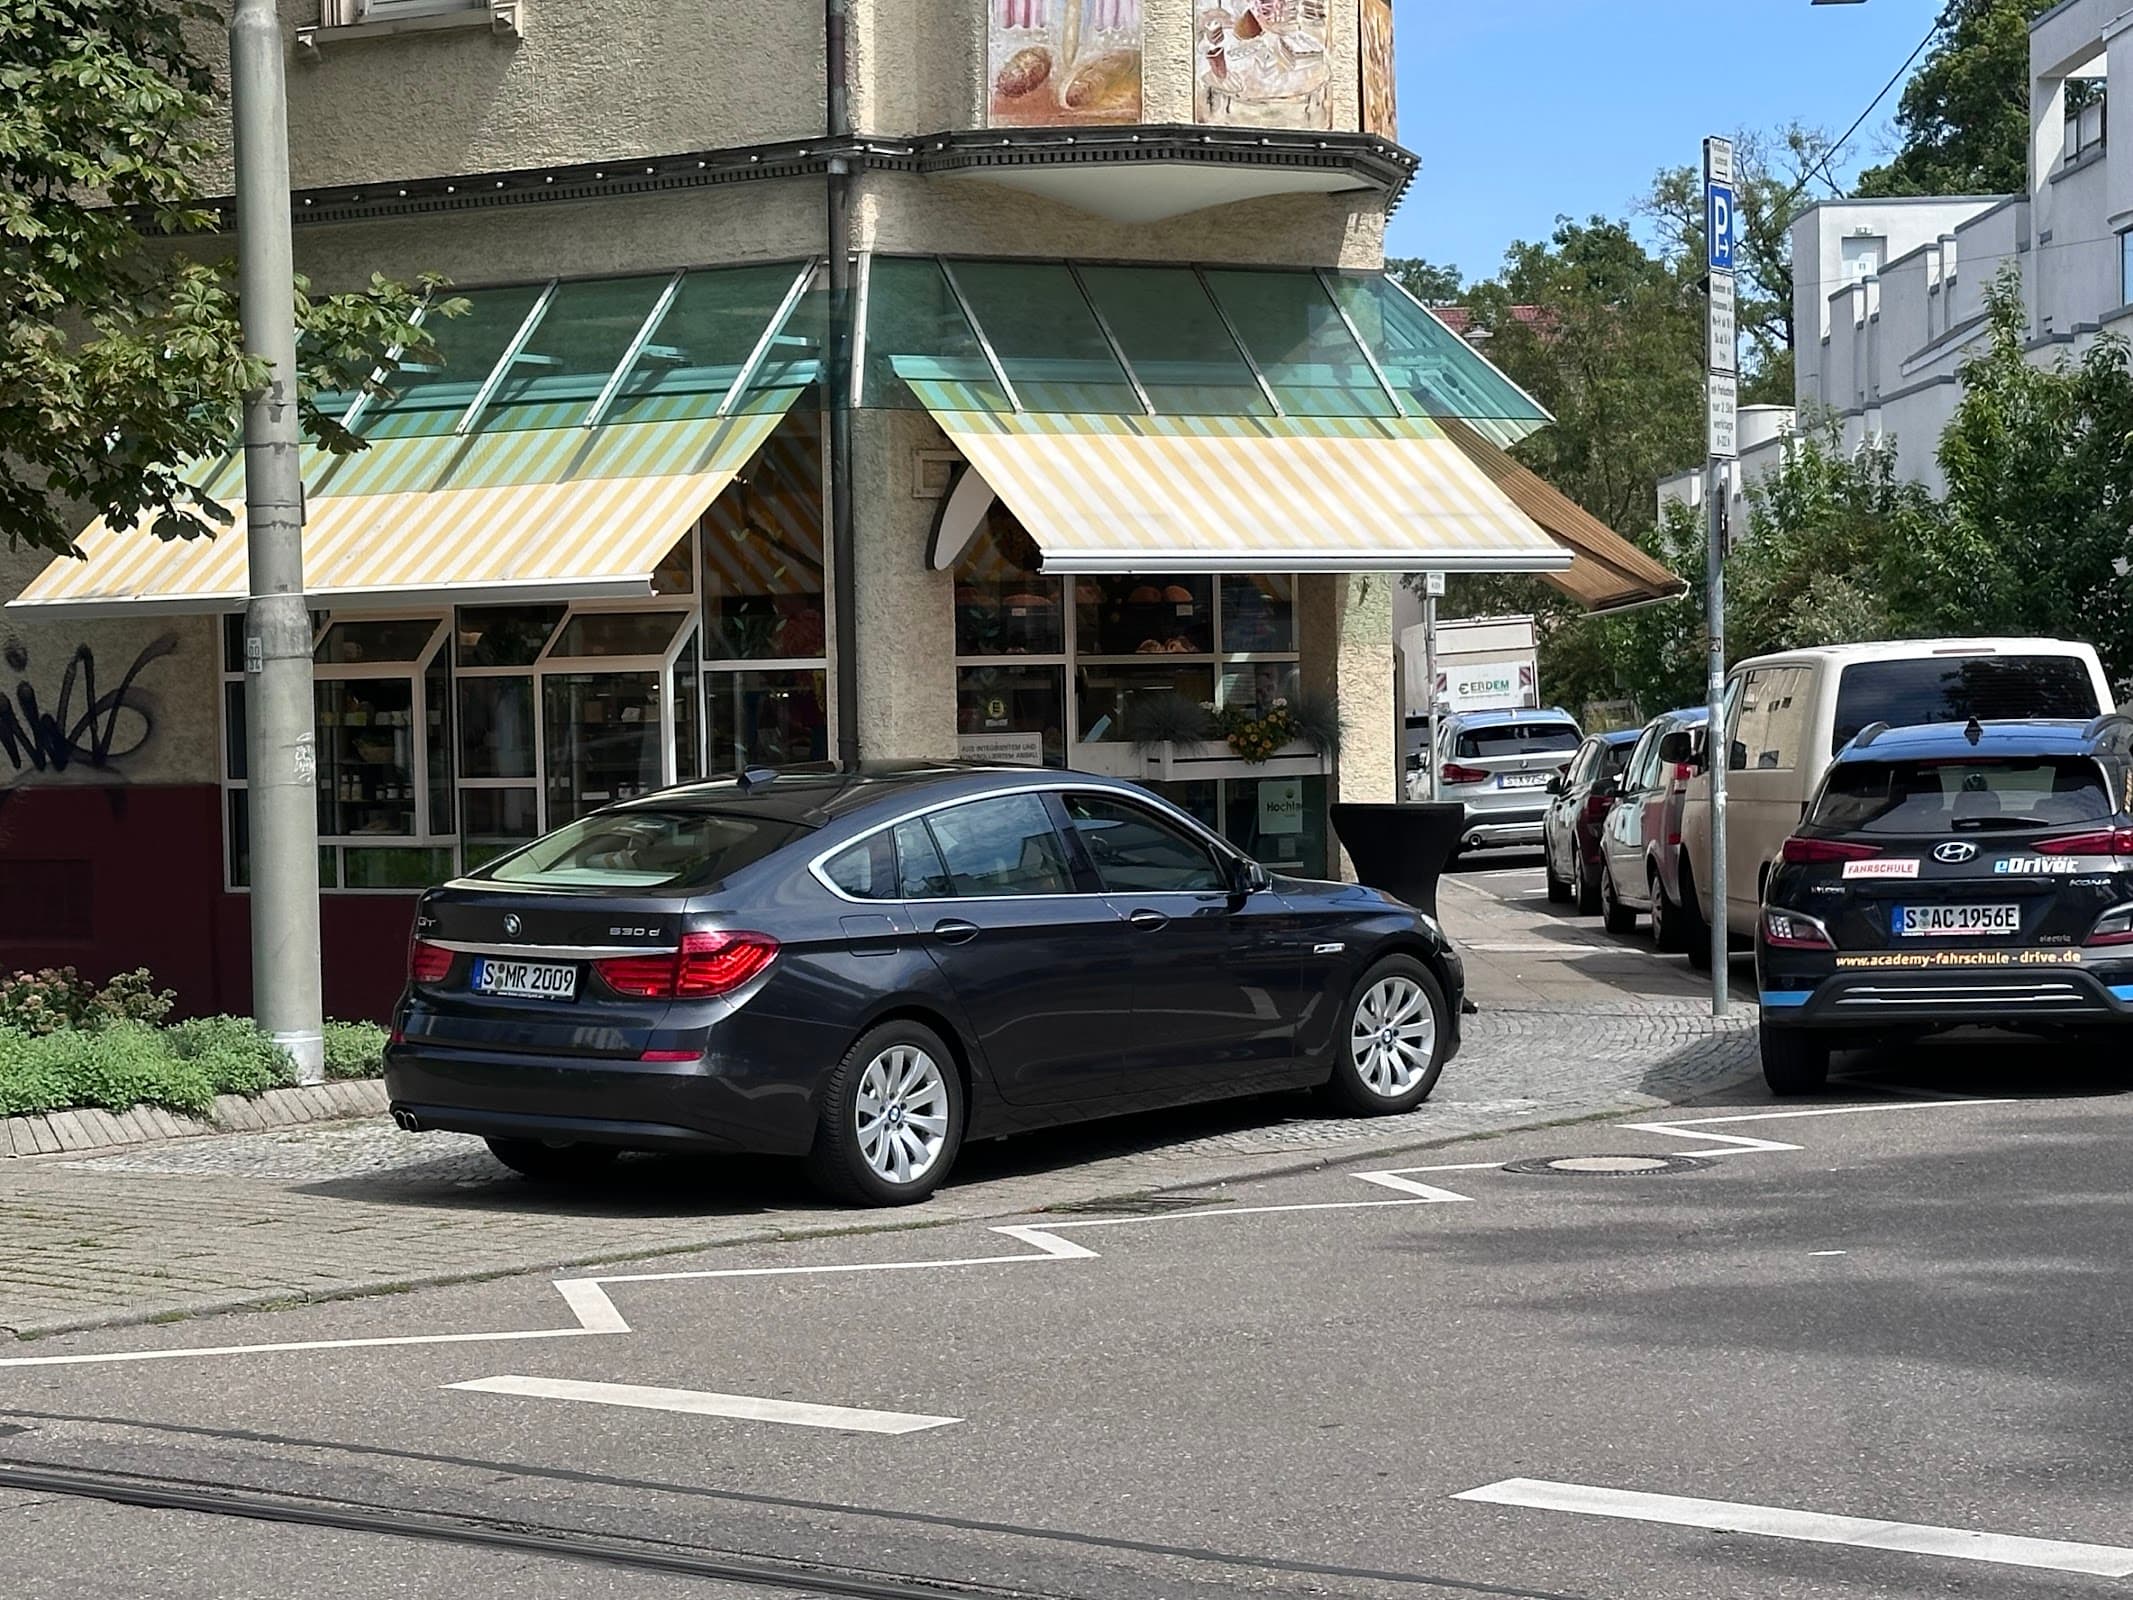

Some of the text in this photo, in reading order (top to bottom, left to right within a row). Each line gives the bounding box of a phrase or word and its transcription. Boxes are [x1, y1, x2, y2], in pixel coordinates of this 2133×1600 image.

[1714, 195, 1729, 258] P
[1847, 863, 1914, 875] FAHRSCHULE
[2068, 878, 2112, 887] KONA
[417, 916, 437, 927] GT
[1905, 907, 2017, 929] S AC 1956E
[609, 927, 645, 936] 530
[483, 963, 574, 992] S MR 2009
